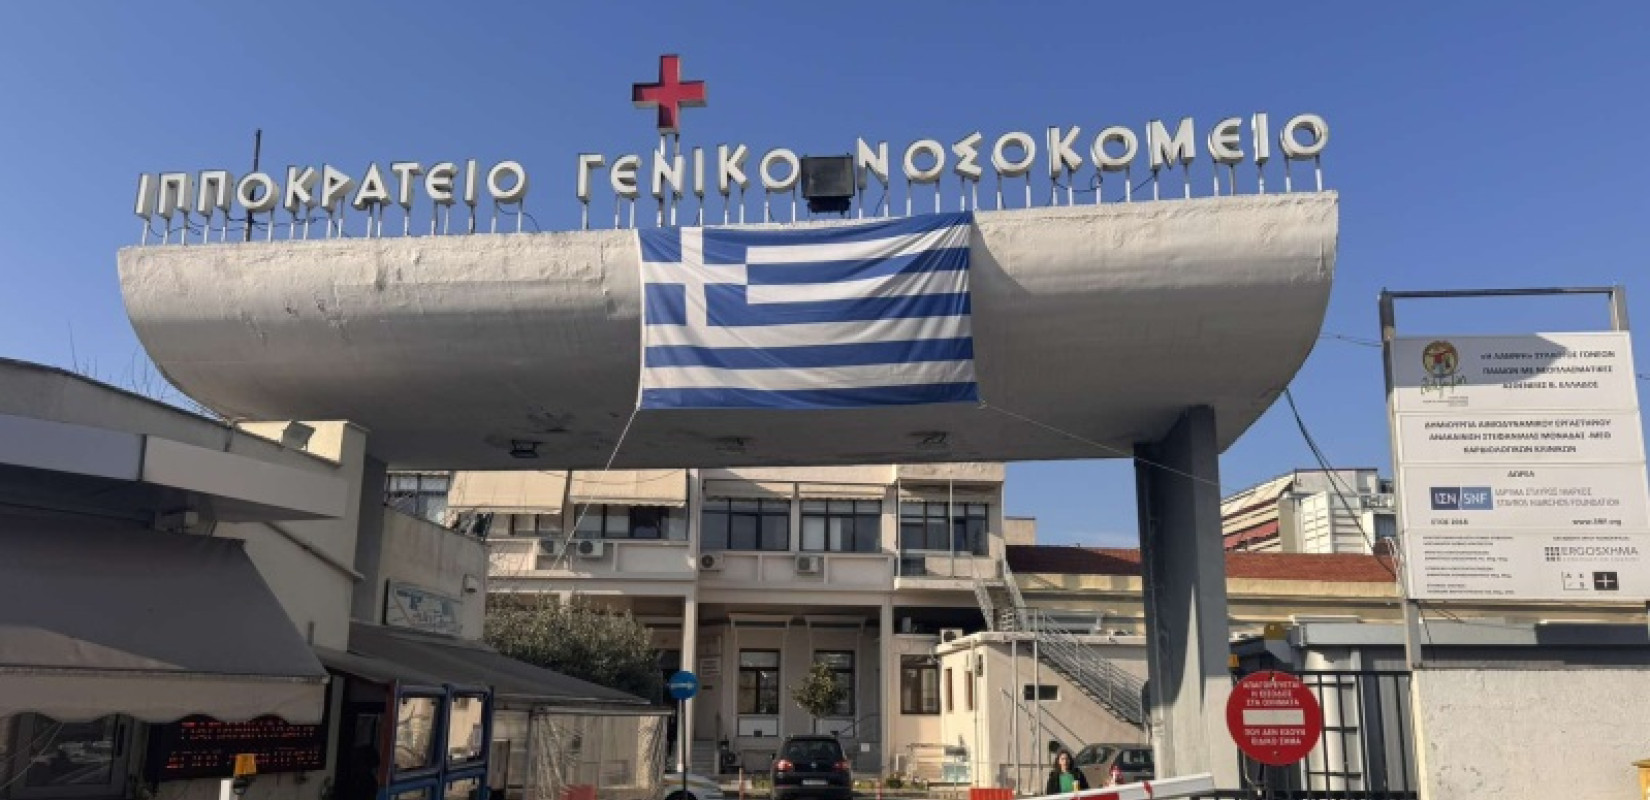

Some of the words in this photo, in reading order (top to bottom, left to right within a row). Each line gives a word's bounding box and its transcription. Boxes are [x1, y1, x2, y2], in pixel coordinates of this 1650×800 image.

[135, 159, 529, 218] ΙΠΠΟΚΡΑΤΕΙΟ
[576, 144, 799, 199] ΓΕΝΙΚΟ
[856, 112, 1329, 189] ΝΟΣΟΚΟΜΕΙΟ
[1463, 492, 1488, 505] SNF
[1561, 546, 1639, 556] ERGOSXHMA
[1262, 728, 1278, 736] ΔΕΝ
